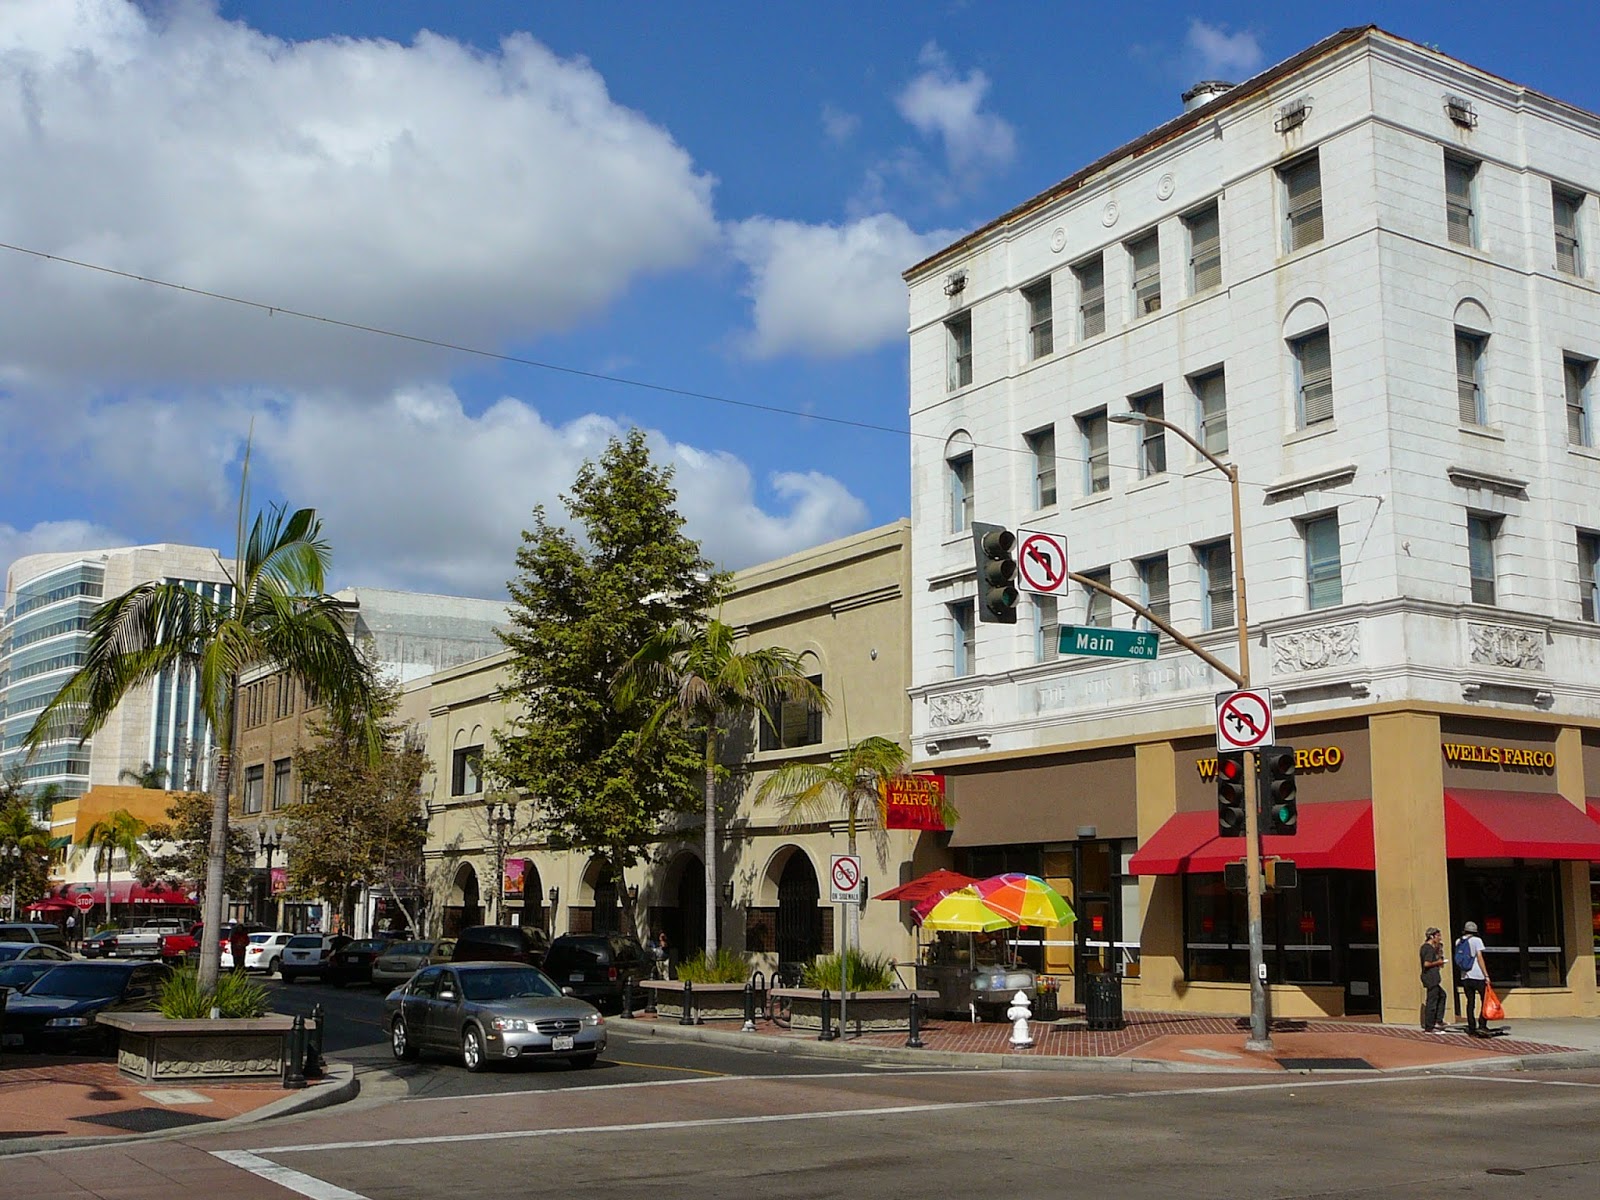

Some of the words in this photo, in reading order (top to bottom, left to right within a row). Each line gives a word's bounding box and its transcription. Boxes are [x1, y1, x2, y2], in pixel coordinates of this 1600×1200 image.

[1076, 633, 1114, 651] Main
[1136, 636, 1147, 645] ST
[1128, 645, 1145, 655] 400
[1146, 646, 1153, 656] N
[1294, 746, 1342, 769] RGO
[1443, 743, 1500, 764] WELLS
[1503, 748, 1556, 769] FARGO
[77, 898, 93, 906] STOP
